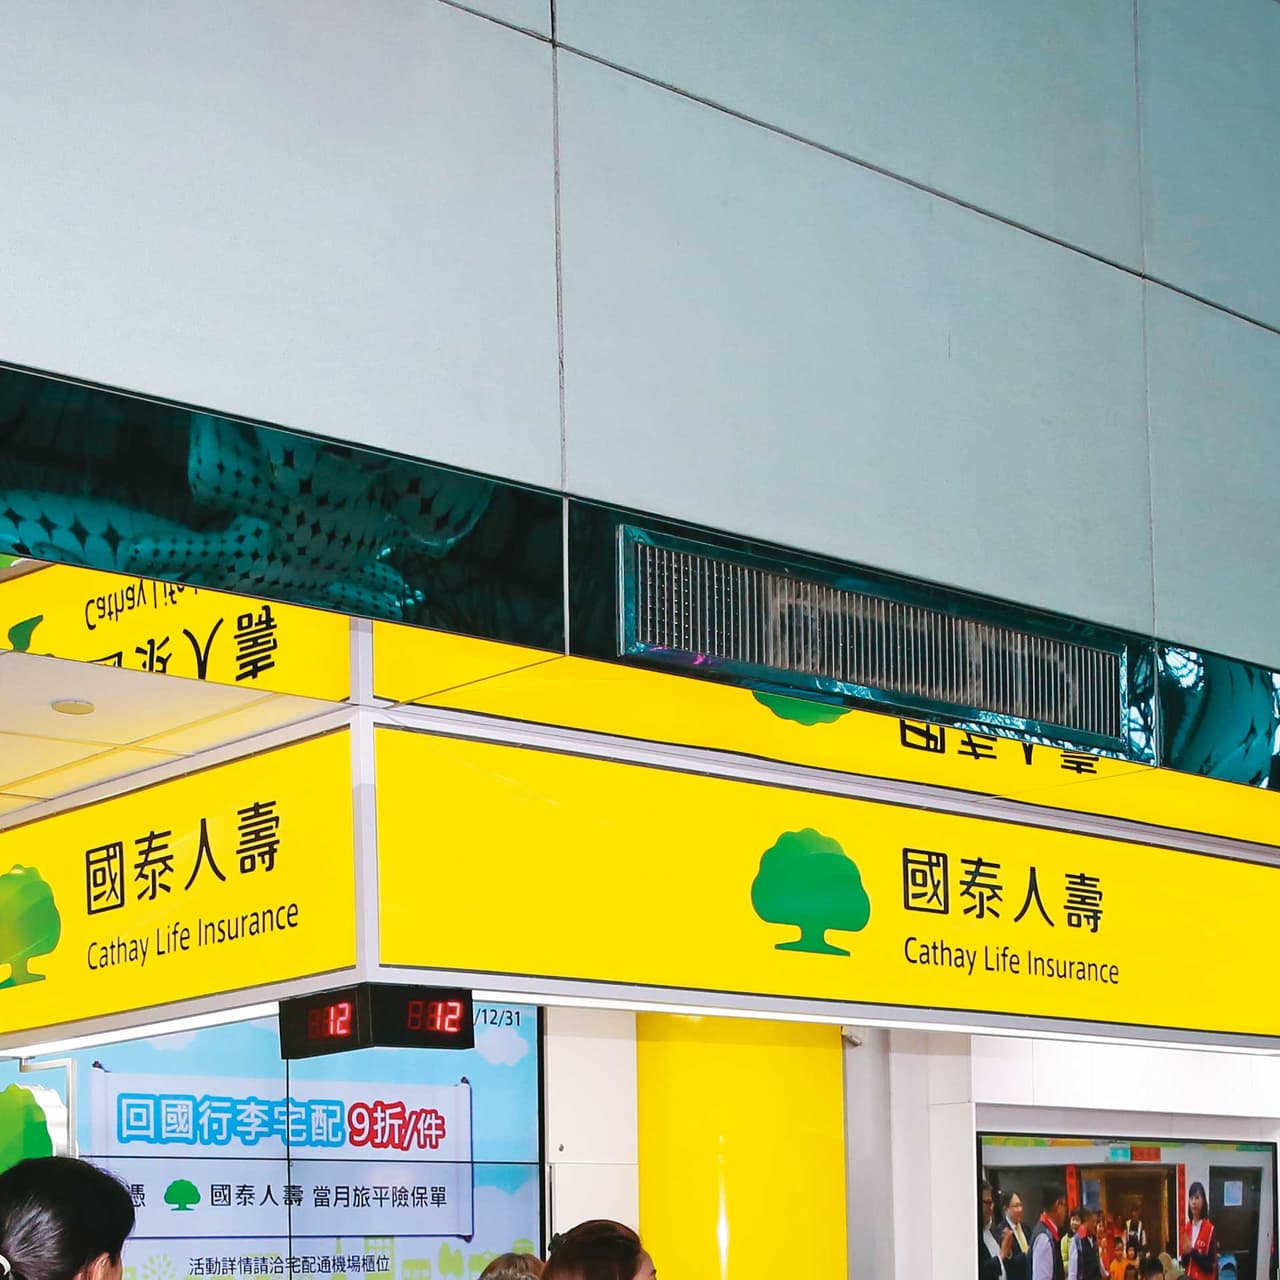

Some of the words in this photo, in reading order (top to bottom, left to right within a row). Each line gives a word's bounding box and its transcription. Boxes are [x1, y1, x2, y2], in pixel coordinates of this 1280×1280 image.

[85, 800, 280, 915] 國泰人壽
[902, 847, 1104, 933] 國泰人壽
[87, 936, 149, 970] Cathay
[156, 921, 190, 956] Life
[198, 903, 299, 947] Insurance
[904, 936, 976, 976] Cathay
[984, 945, 1020, 974] Life
[1028, 950, 1119, 984] Insurance
[211, 1184, 304, 1208] 國泰人壽
[312, 1185, 448, 1208] 當月旅平險保單
[189, 1254, 391, 1277] 活動詳情請洽宅配通機場櫃位
